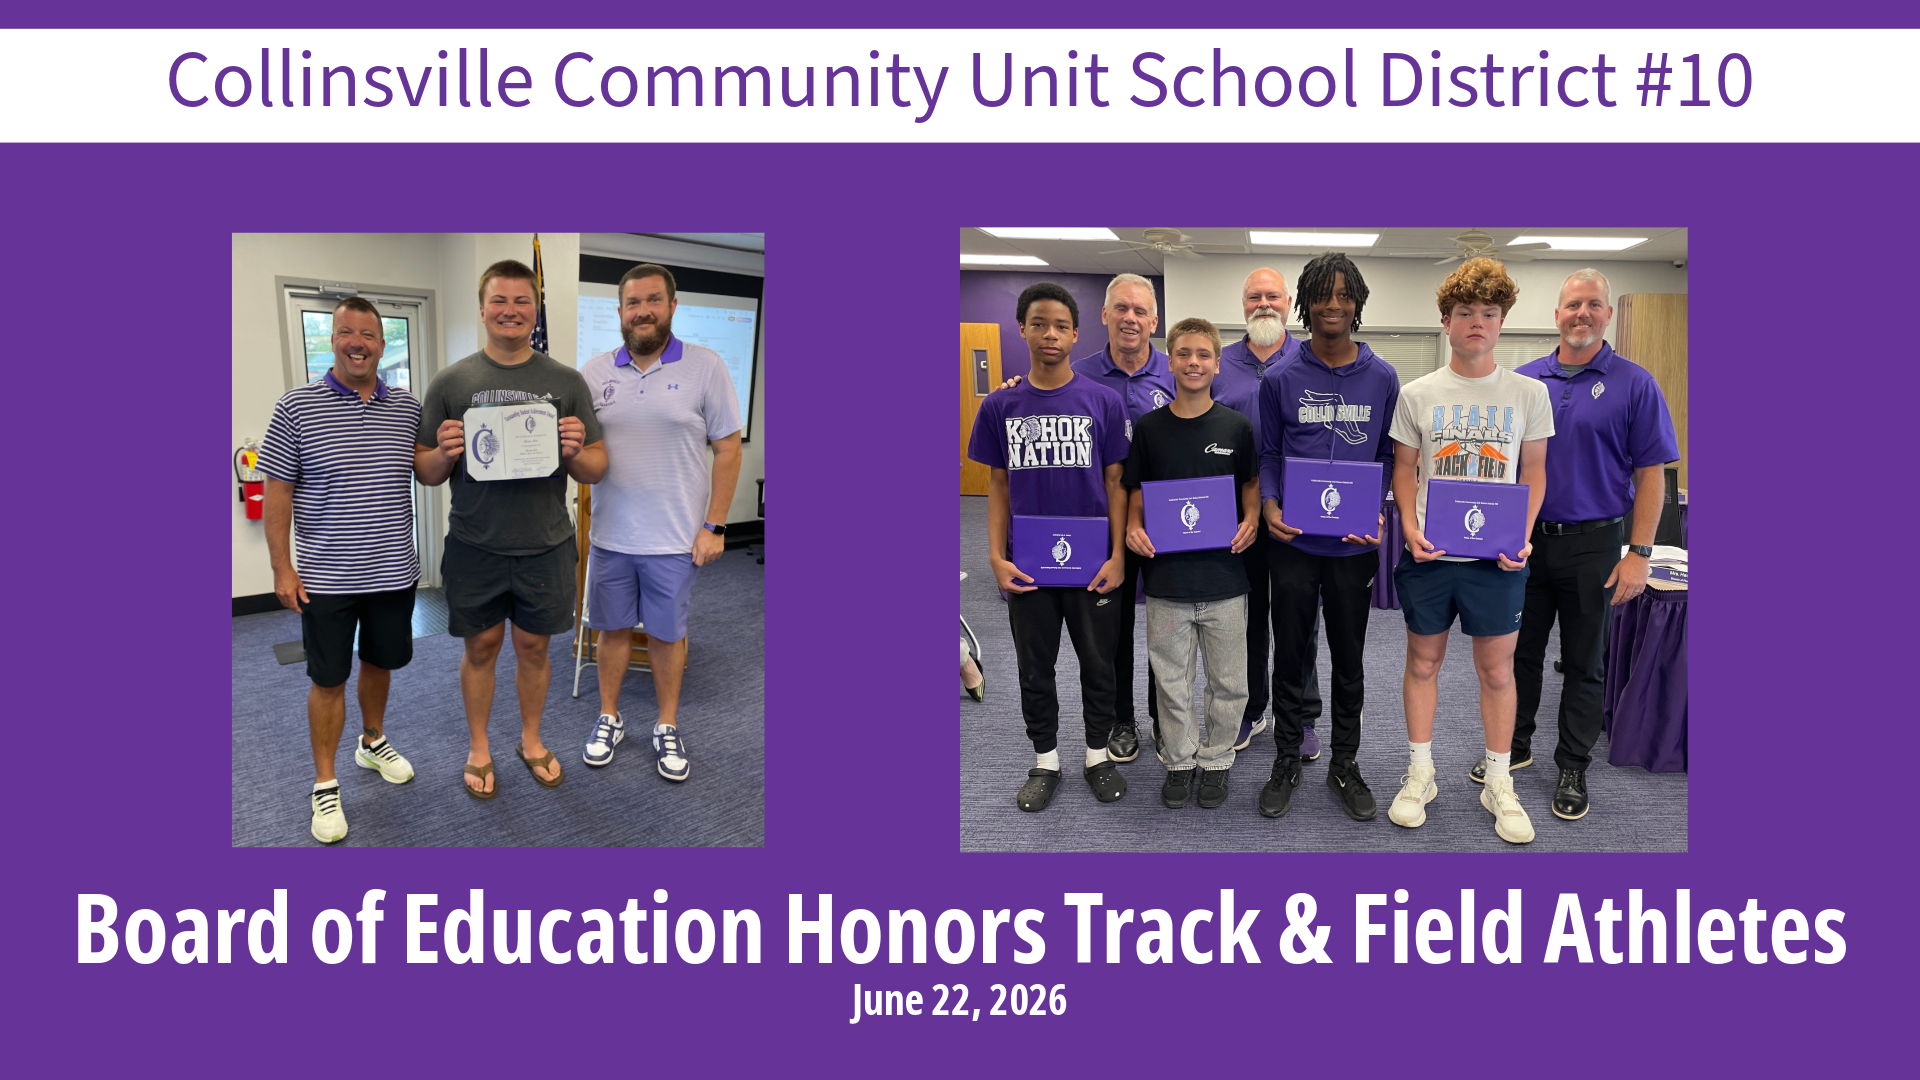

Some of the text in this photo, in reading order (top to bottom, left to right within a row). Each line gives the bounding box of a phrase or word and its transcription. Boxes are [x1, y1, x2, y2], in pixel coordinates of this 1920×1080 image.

[1432, 404, 1514, 434] STATE
[1429, 429, 1514, 444] FINALS
[1008, 441, 1092, 469] NATION
